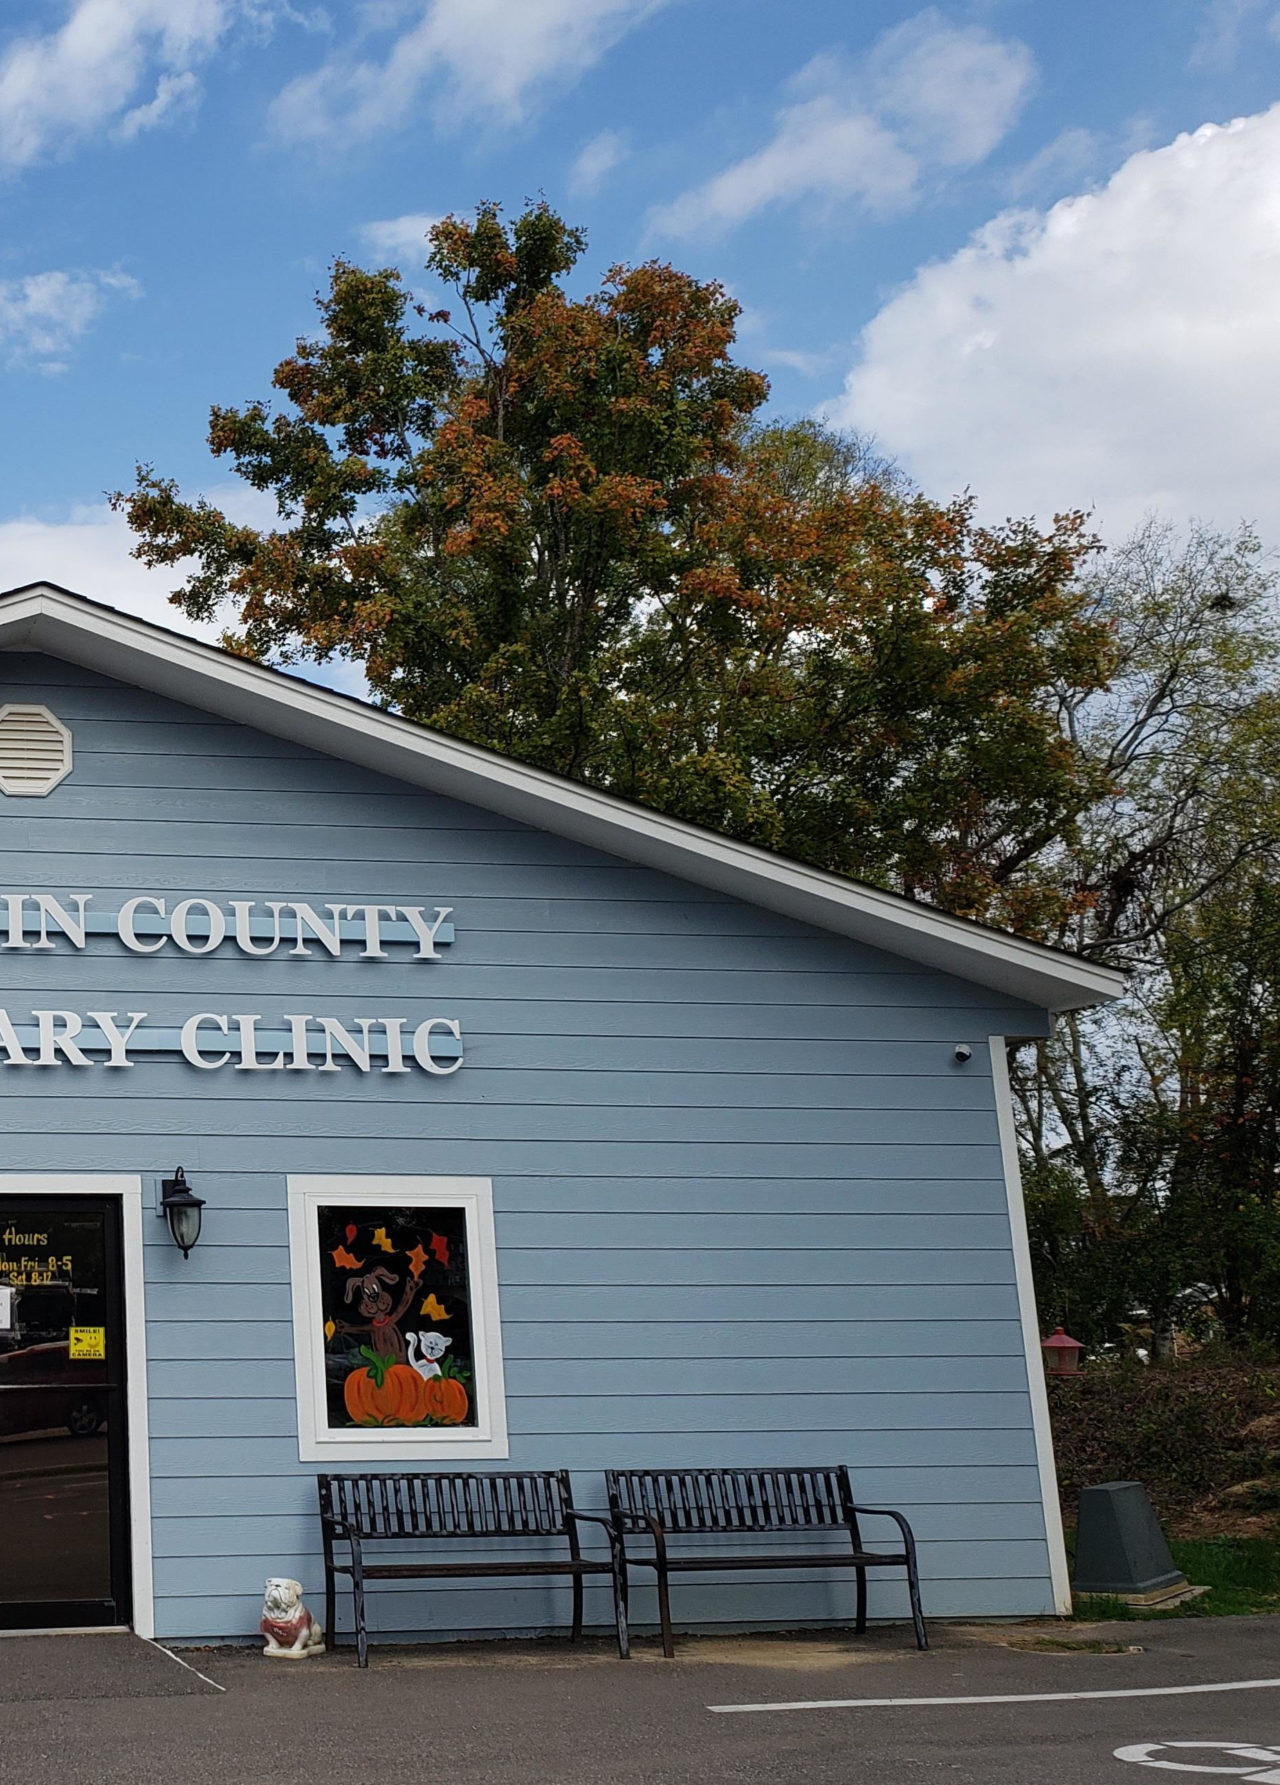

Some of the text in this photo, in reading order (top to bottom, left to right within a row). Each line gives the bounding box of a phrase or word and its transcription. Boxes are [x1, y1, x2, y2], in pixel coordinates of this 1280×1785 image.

[117, 895, 454, 959] COUNTY
[179, 1012, 465, 1075] CLINIC
[2, 1226, 48, 1246] Hours
